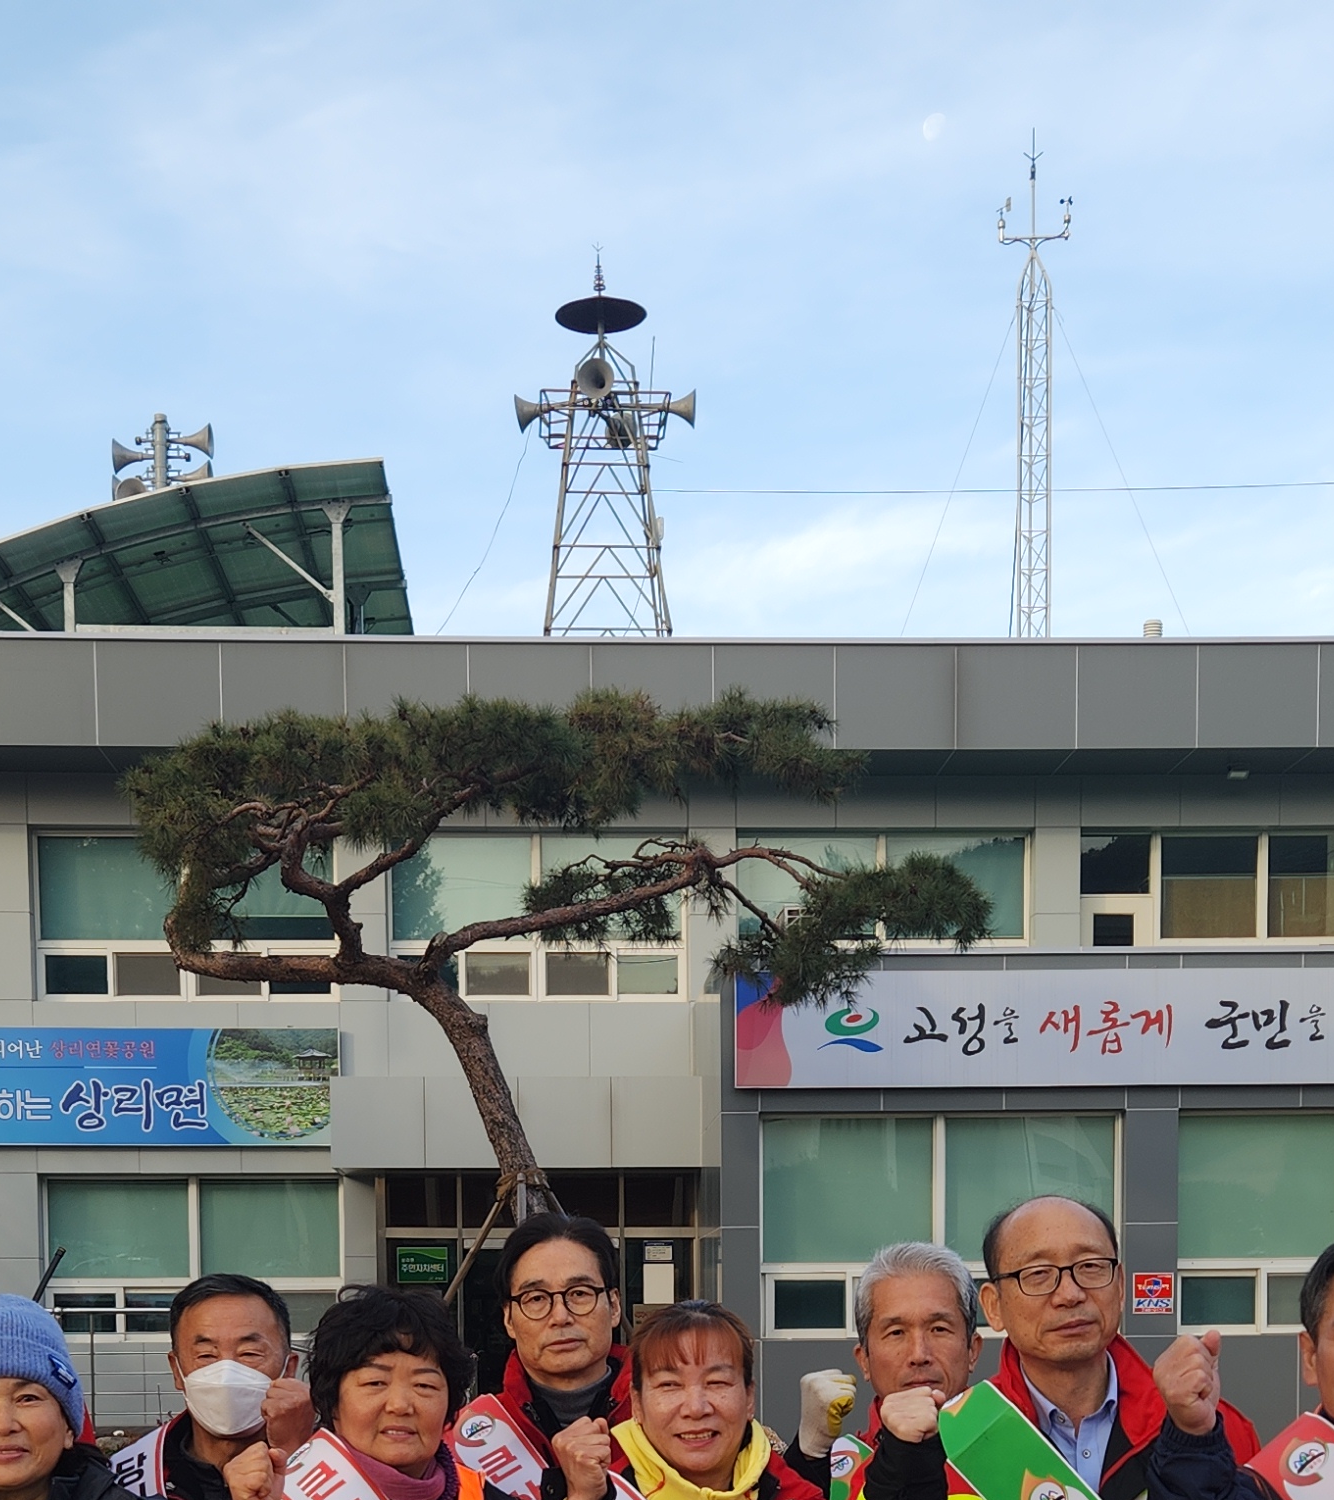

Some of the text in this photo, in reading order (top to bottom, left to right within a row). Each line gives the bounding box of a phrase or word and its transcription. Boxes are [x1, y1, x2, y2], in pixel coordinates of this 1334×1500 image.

[50, 1039, 156, 1060] 상리연꽃공원
[903, 1003, 1020, 1057] 고성을
[1038, 1001, 1173, 1055] 새롭게
[1204, 1000, 1326, 1051] 군민을
[60, 1078, 208, 1133] 상리면
[478, 1444, 522, 1484] 큰
